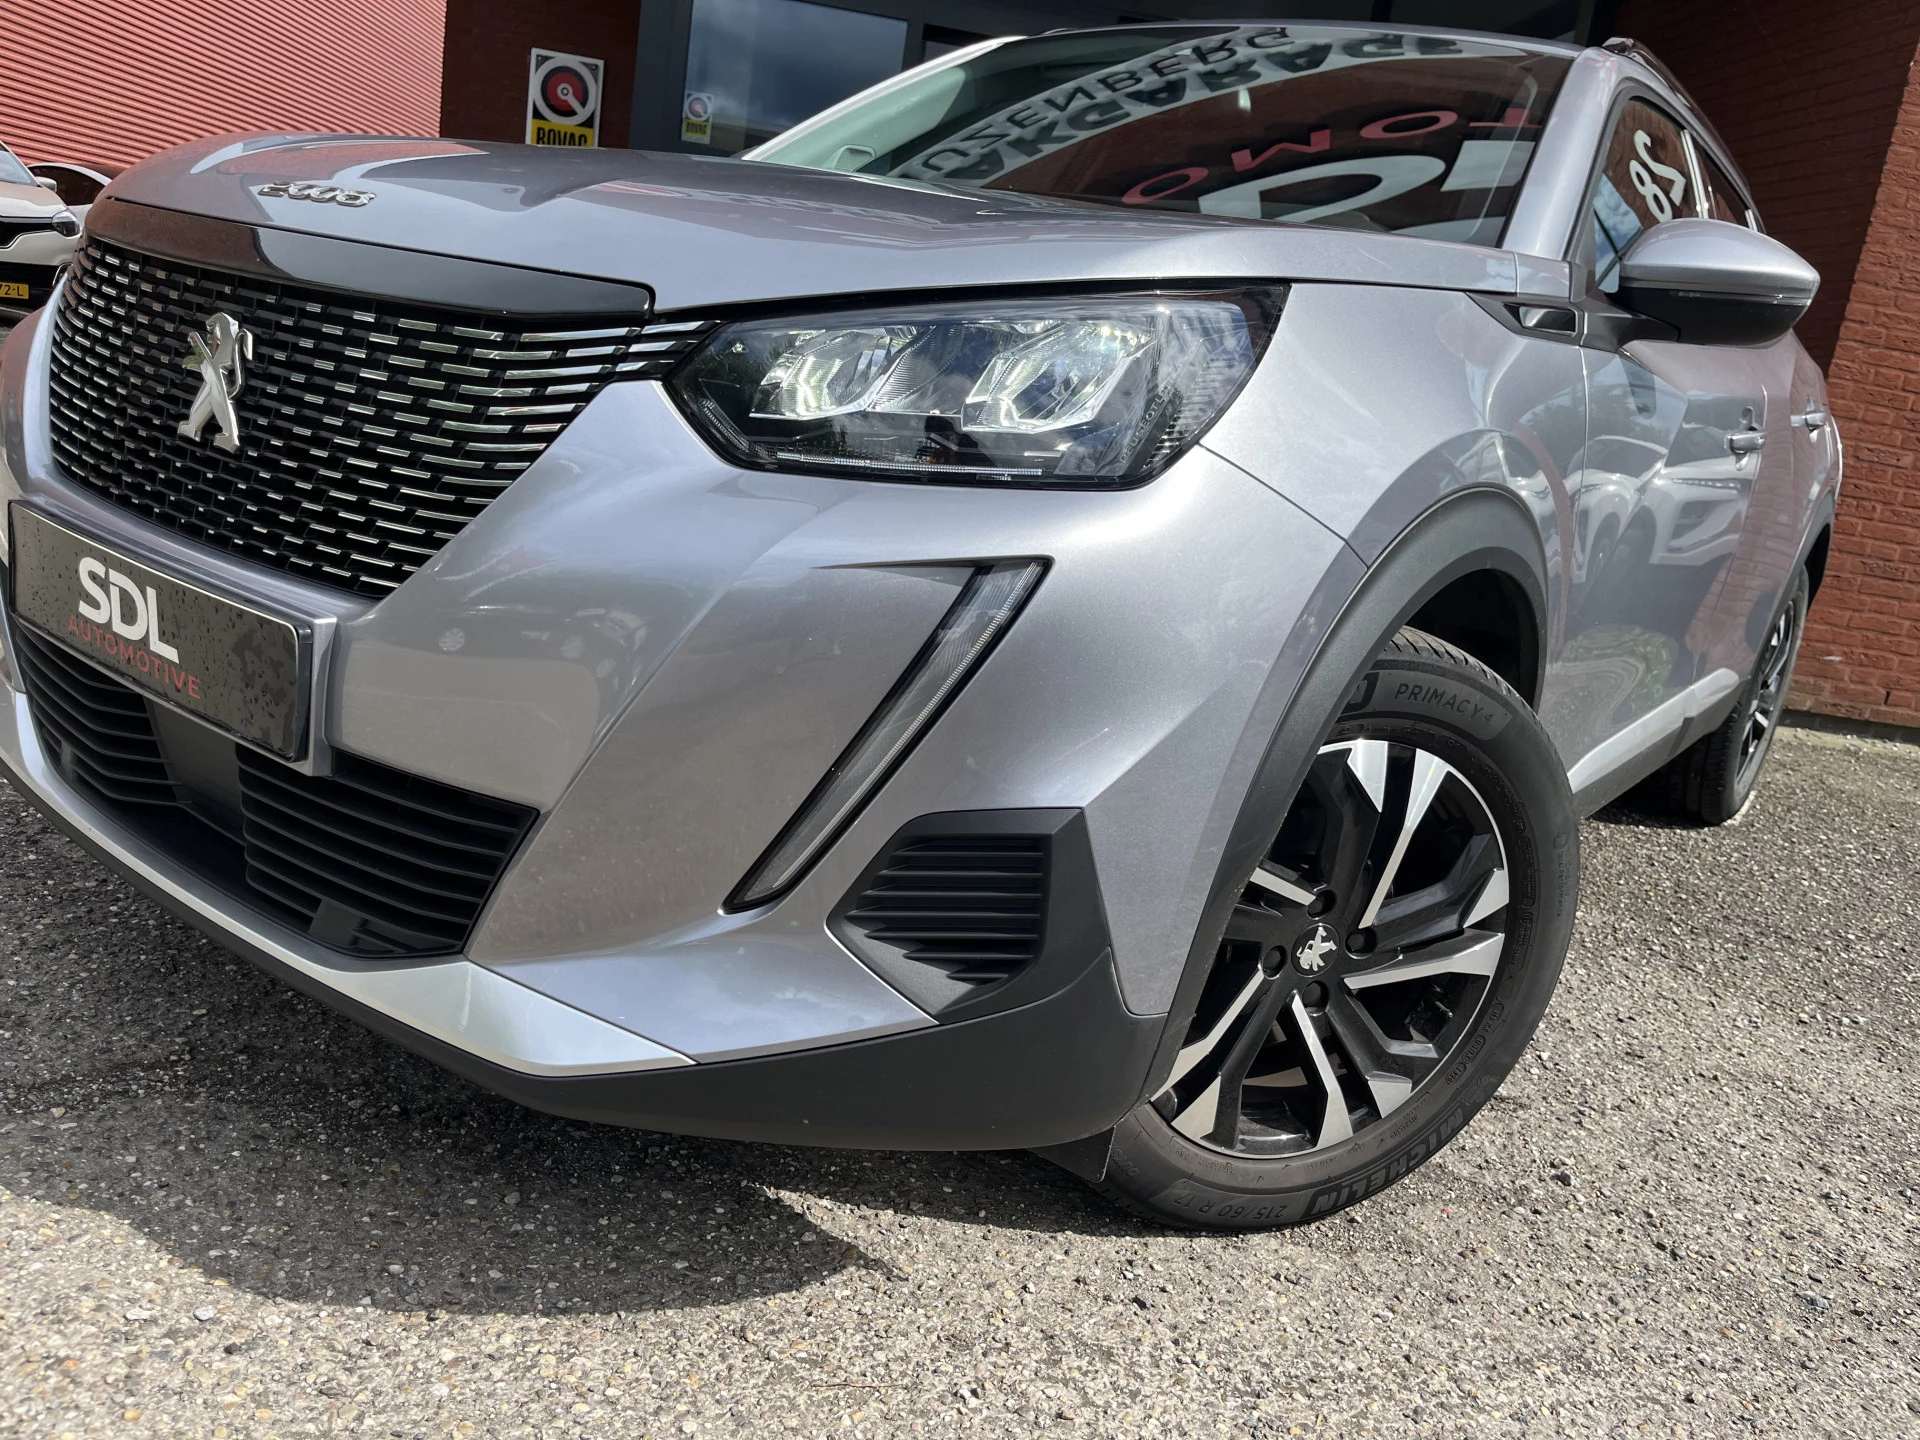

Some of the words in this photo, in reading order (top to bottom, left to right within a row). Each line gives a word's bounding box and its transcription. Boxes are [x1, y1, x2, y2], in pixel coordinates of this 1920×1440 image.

[1119, 401, 1158, 464] PEUGEOT
[78, 556, 180, 664] SDL
[68, 614, 201, 699] AUTOMOTIVE
[1394, 683, 1485, 719] PRIMACY
[1310, 1109, 1464, 1215] MICHELIN
[1171, 1193, 1198, 1208] 17
[1198, 1200, 1216, 1214] R
[1217, 1204, 1288, 1220] 215/60
